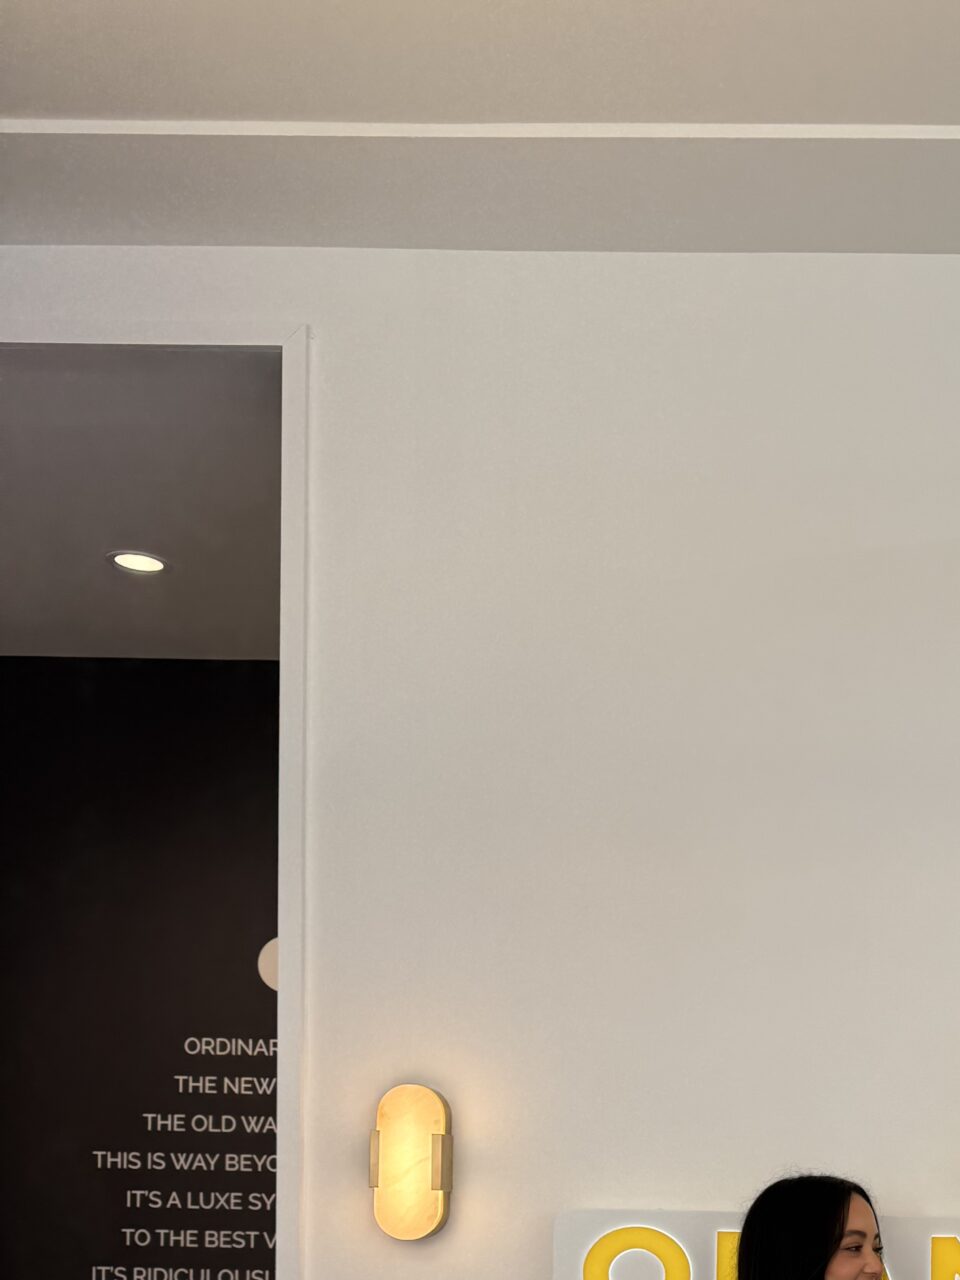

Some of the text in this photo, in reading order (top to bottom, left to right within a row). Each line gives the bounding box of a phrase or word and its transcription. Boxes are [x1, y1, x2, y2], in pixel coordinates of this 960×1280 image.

[174, 1075, 277, 1095] THE NEW
[142, 1114, 186, 1131] THE
[191, 1115, 236, 1133] OLD
[92, 1151, 141, 1169] THIS
[147, 1152, 166, 1170] IS
[170, 1153, 220, 1171] WAY
[126, 1190, 276, 1211] IT'S A LUXE SY
[121, 1229, 151, 1246] TO
[155, 1230, 199, 1247] THE
[204, 1231, 259, 1249] BEST
